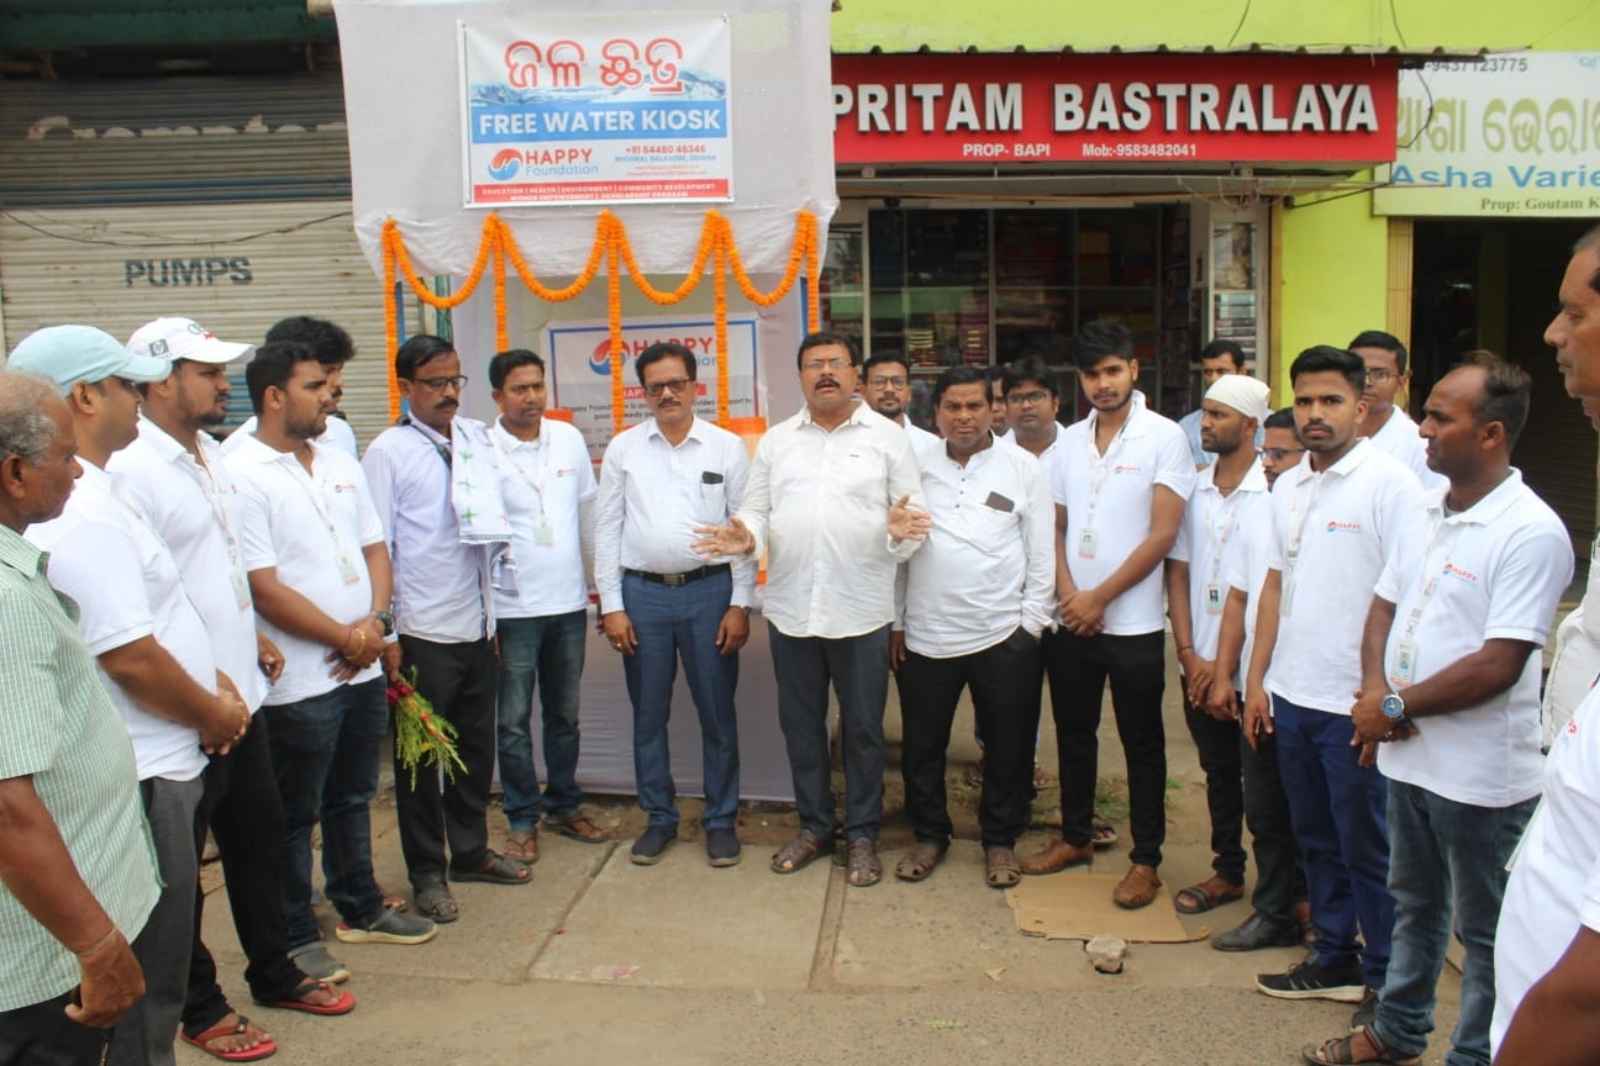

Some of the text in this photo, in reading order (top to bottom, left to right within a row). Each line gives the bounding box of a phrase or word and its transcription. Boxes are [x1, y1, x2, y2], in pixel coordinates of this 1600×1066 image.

[504, 40, 585, 88] ଜଳ
[832, 83, 1379, 132] PRITAM BASTRALAYA
[479, 109, 721, 135] FREE WATER KIOSK
[525, 148, 593, 165] HAPPY
[1014, 143, 1050, 157] BAPI
[525, 165, 600, 176] Foundation
[1391, 165, 1494, 188] Asha
[1481, 198, 1520, 213] Prop:
[1525, 198, 1583, 211] Goutam
[125, 256, 253, 287] PUMPS
